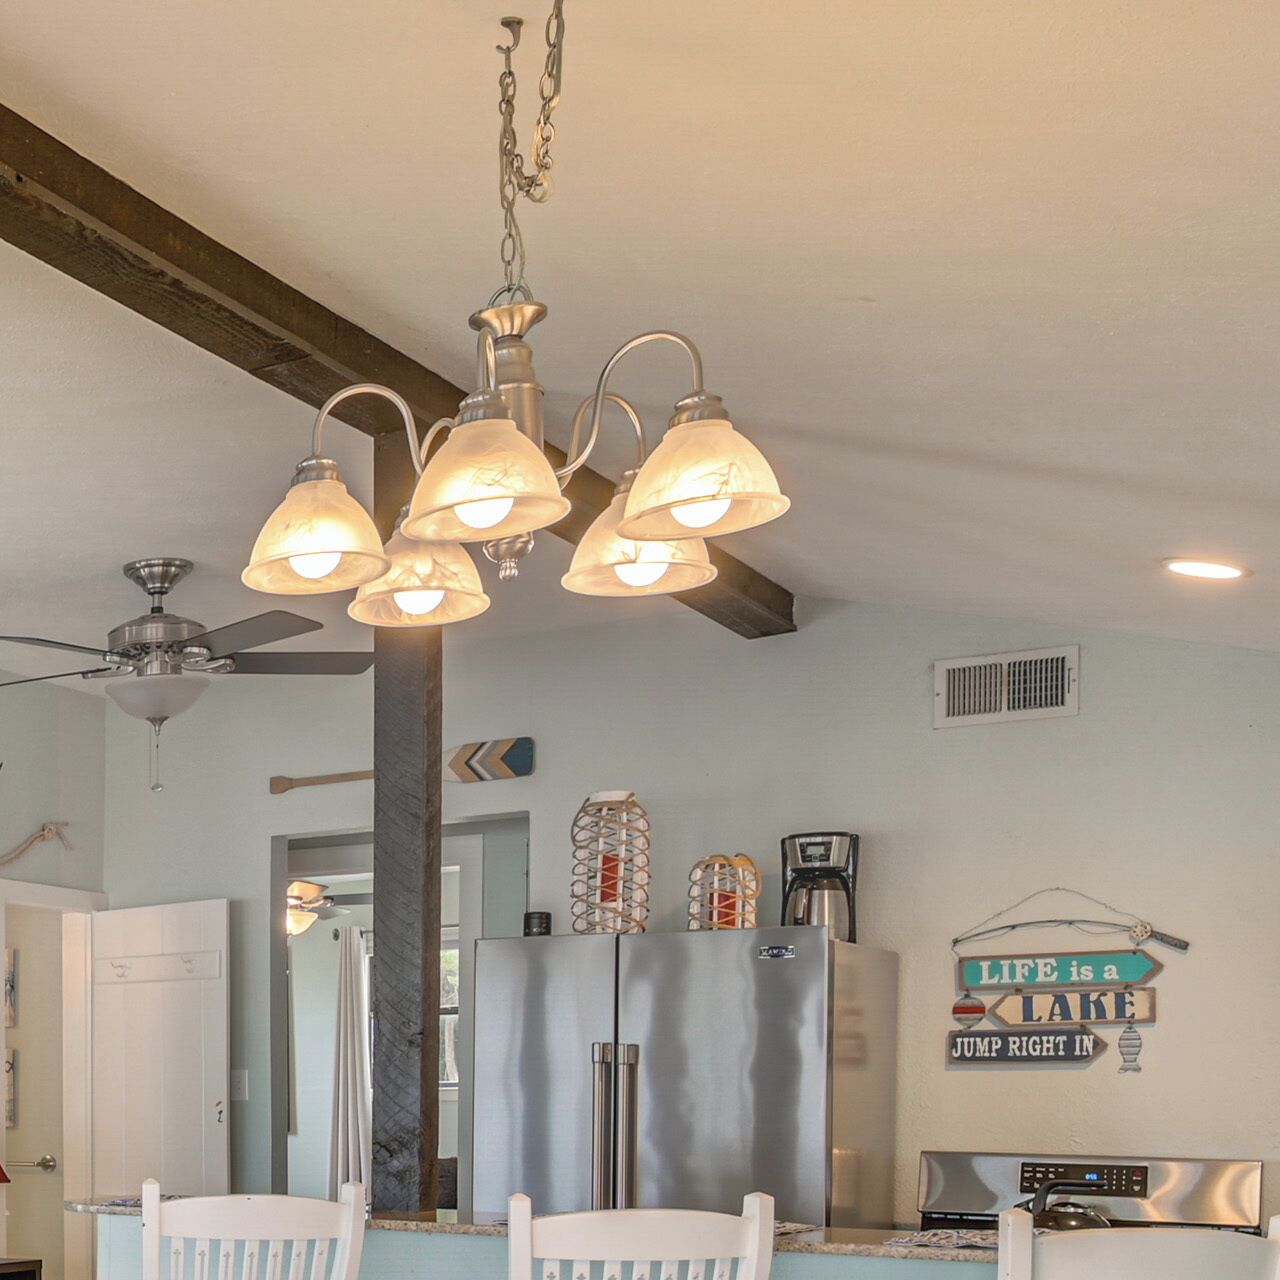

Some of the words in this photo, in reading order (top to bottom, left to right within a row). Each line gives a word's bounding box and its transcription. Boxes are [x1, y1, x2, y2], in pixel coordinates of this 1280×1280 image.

[979, 958, 1058, 985] LIFE
[1070, 960, 1094, 981] is
[1103, 964, 1120, 980] a
[1021, 991, 1136, 1023] LAKE
[952, 1036, 1002, 1058] JUMP
[1008, 1035, 1067, 1057] RIGHT
[1074, 1034, 1095, 1056] IN
